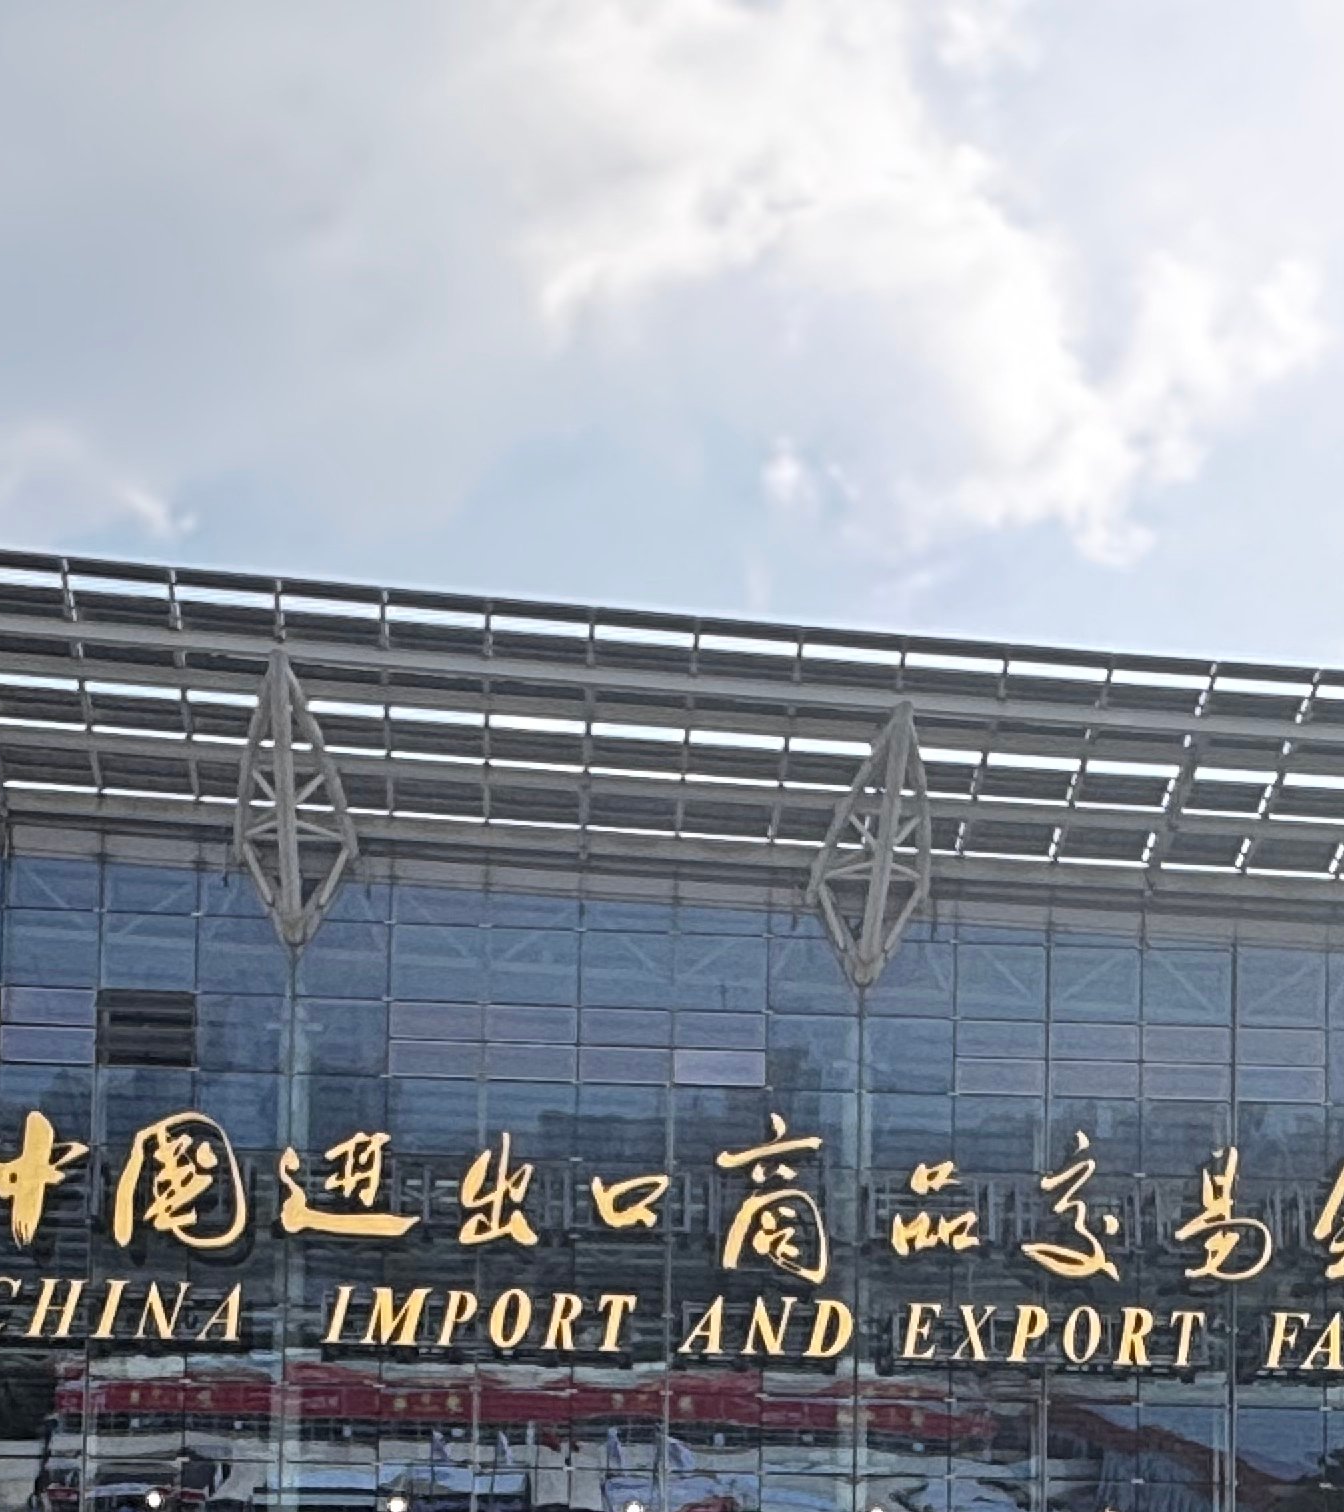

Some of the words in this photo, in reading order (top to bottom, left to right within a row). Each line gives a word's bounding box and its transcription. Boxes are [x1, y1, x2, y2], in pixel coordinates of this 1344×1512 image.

[321, 1285, 637, 1353] IMPORT
[678, 1295, 855, 1358] AND
[901, 1302, 1206, 1367] EXPORT
